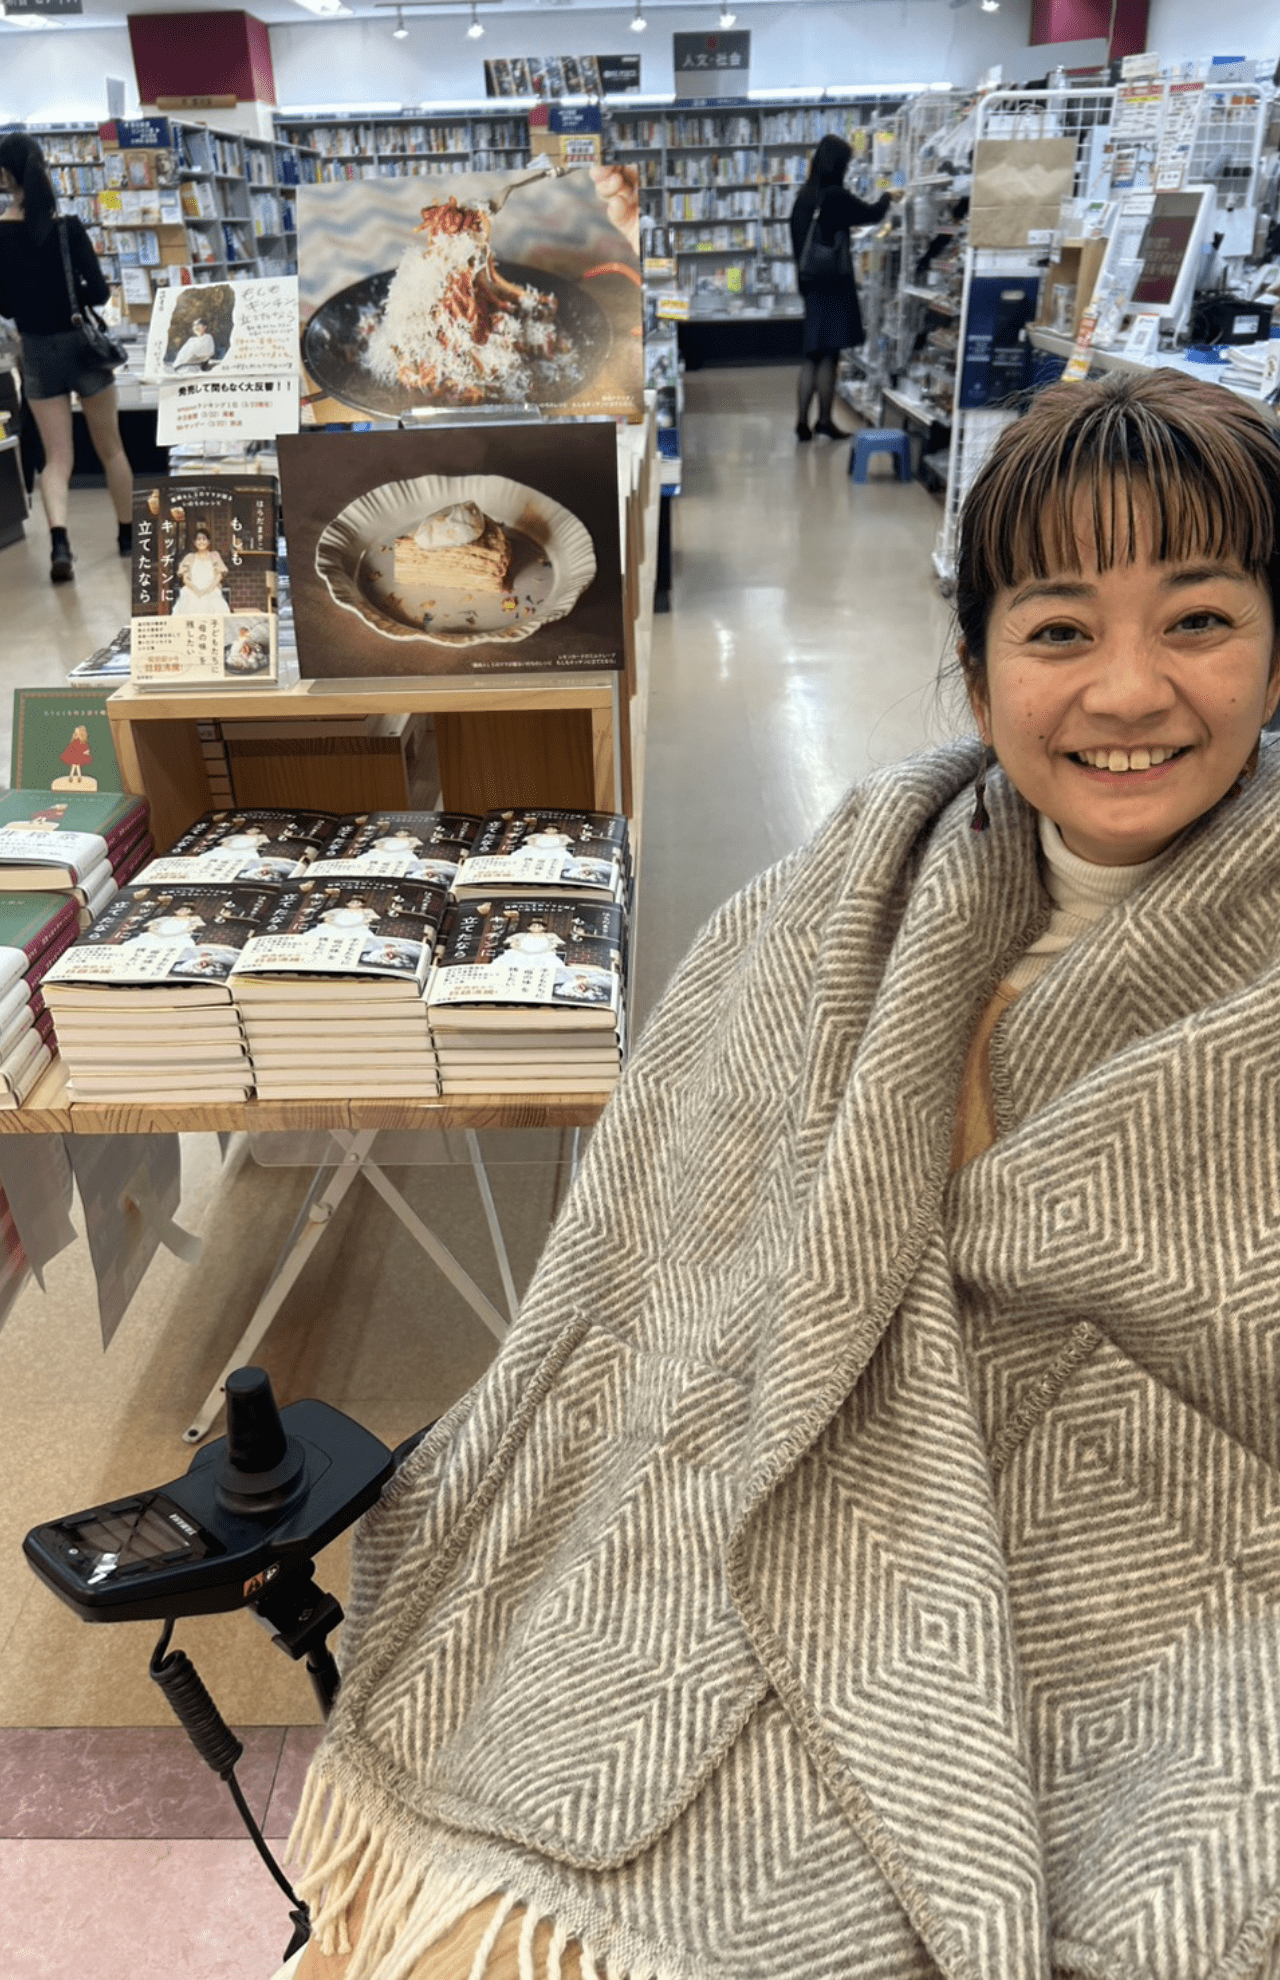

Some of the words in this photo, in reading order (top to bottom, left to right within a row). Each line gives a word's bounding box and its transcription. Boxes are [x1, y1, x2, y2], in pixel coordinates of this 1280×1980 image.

[682, 51, 741, 67] 人文・社会
[138, 520, 152, 603] 立てたなら
[160, 520, 174, 601] キッチンに
[231, 517, 243, 565] もしも
